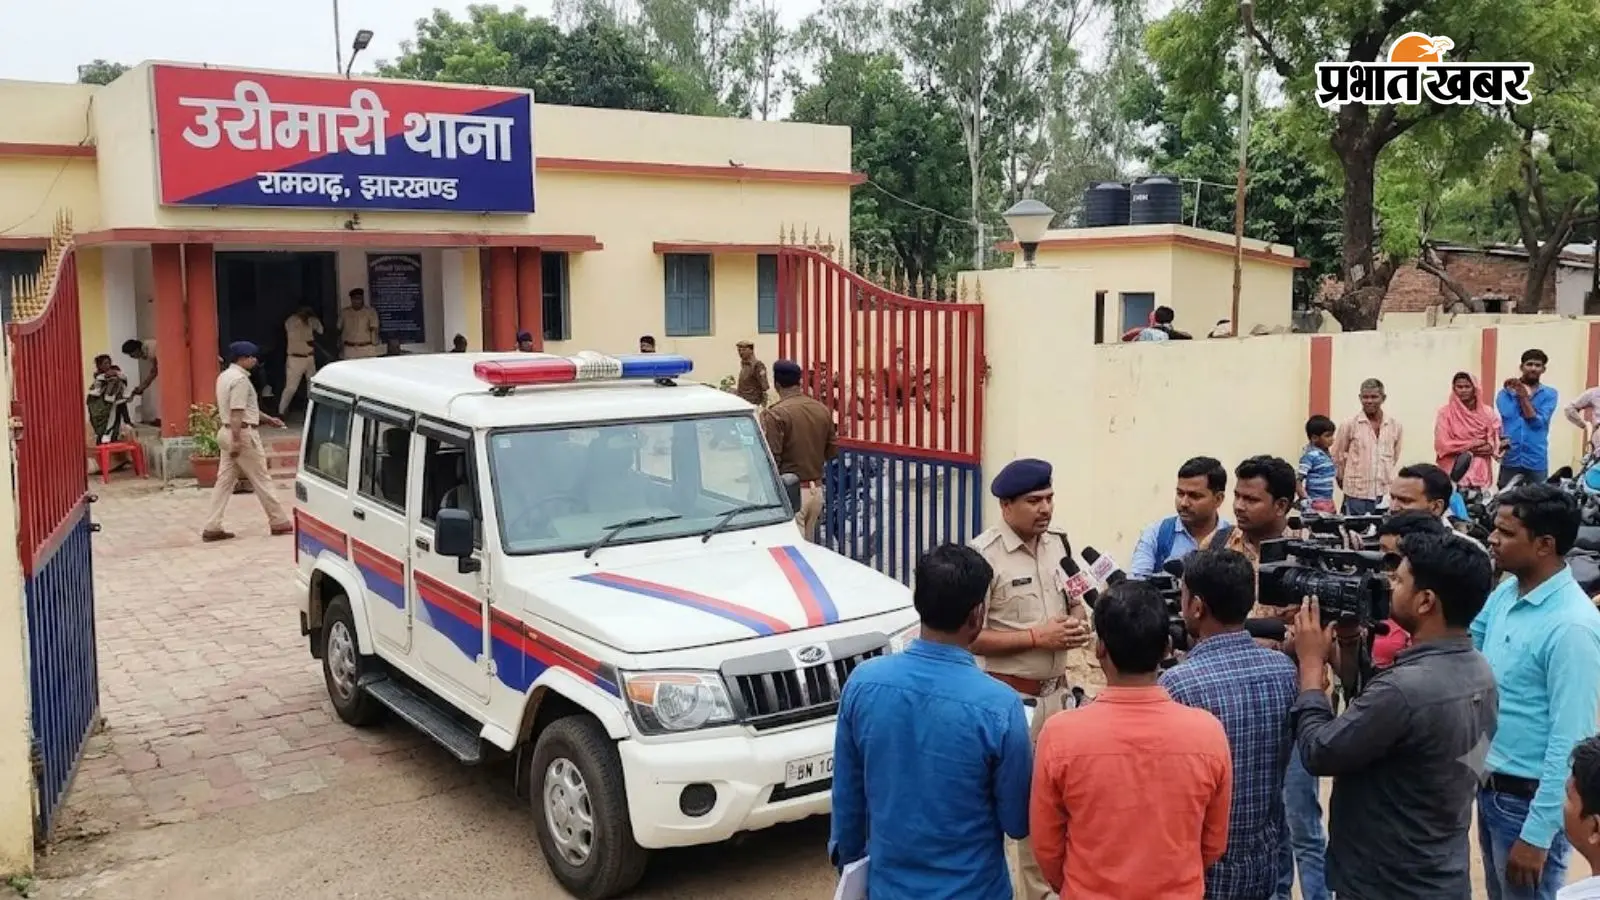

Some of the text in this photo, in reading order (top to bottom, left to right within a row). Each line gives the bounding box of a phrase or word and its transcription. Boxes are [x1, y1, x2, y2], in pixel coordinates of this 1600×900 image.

[179, 80, 514, 162] उरीमारी थाना
[257, 172, 460, 202] रामगढ़, झारखण्ड
